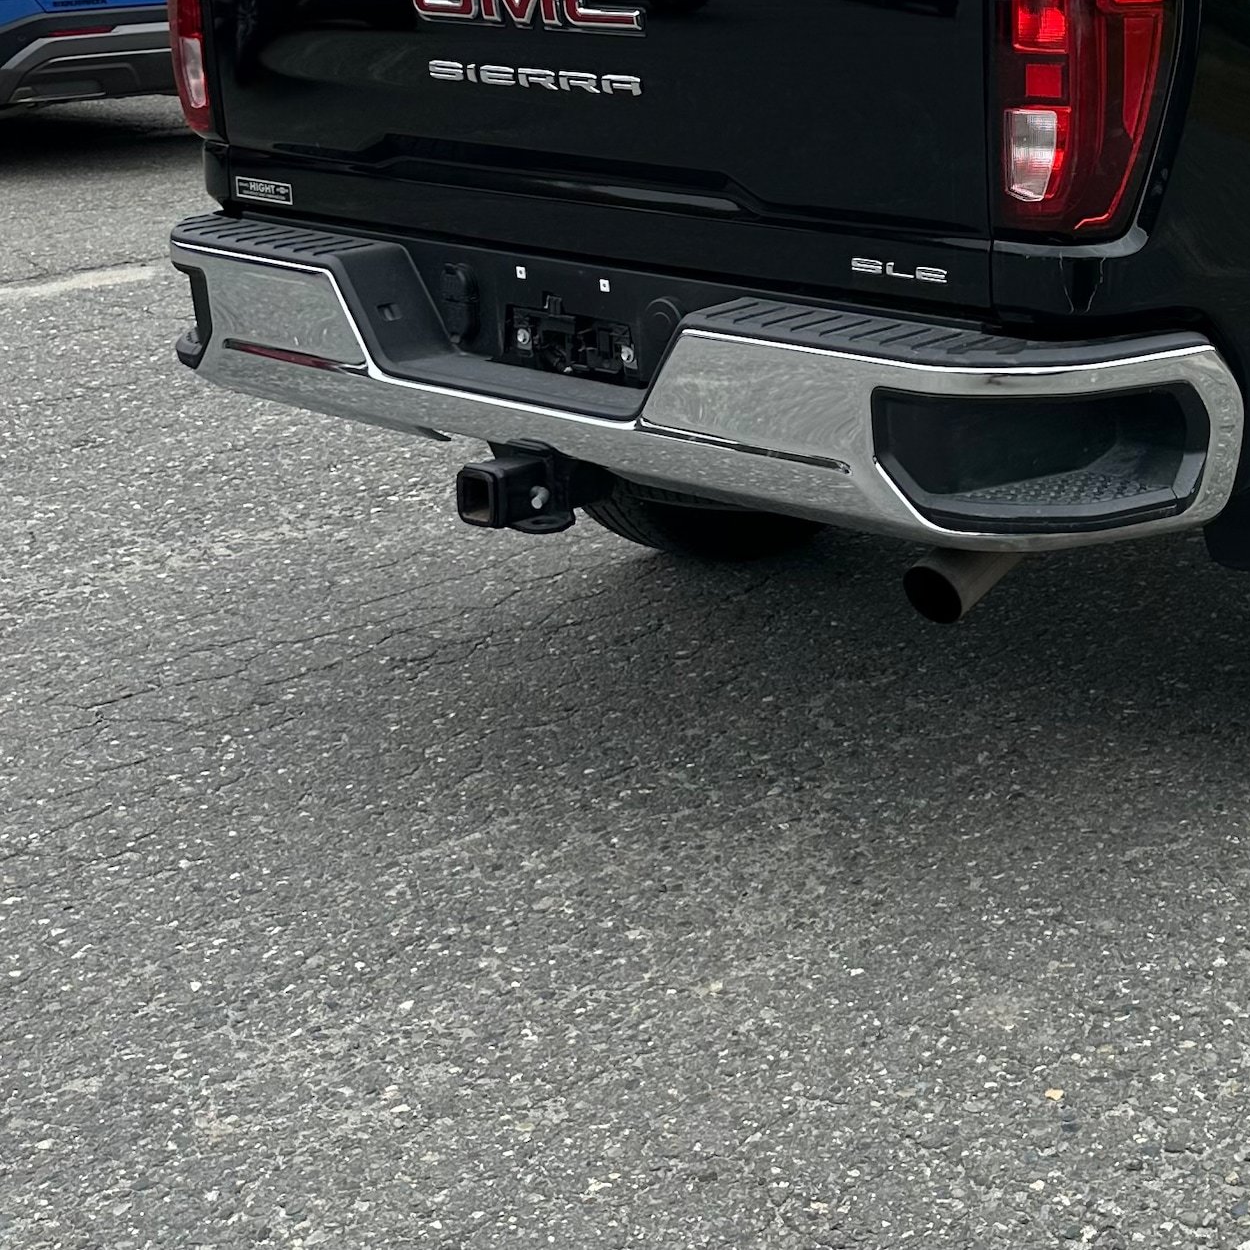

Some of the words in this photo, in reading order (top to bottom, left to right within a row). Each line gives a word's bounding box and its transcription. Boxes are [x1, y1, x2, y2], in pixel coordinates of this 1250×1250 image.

[428, 59, 642, 96] SIERRA
[249, 181, 275, 194] HIGHT
[851, 256, 948, 284] SLE
